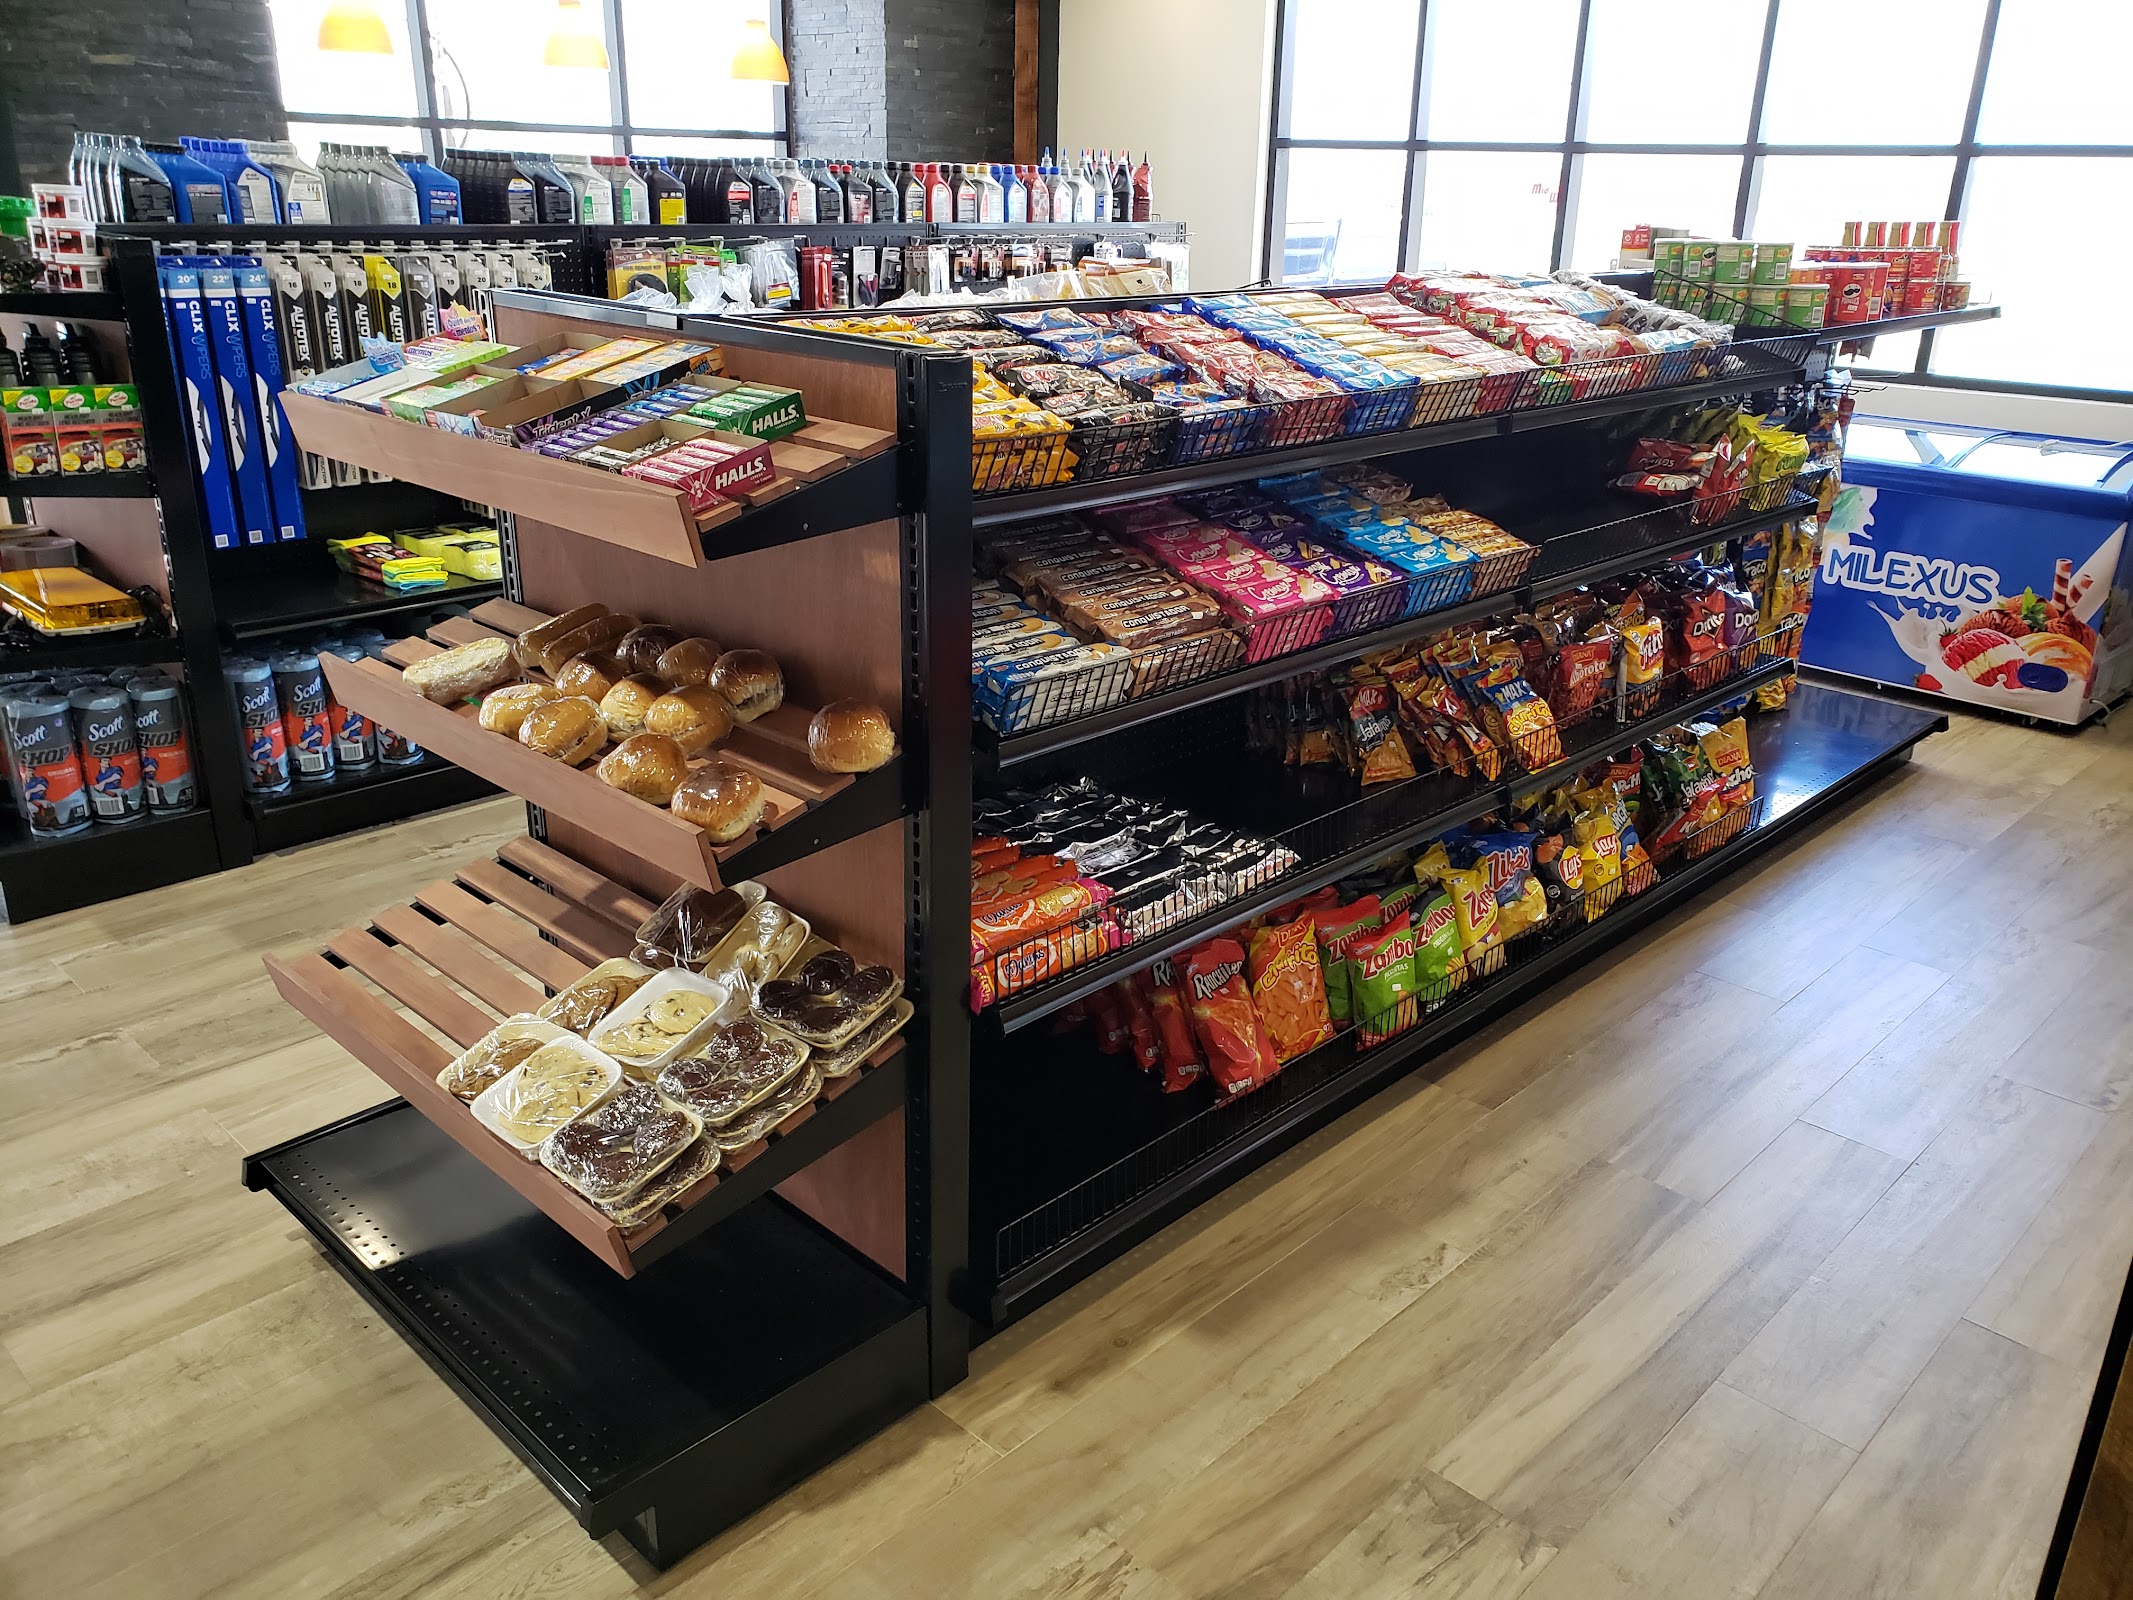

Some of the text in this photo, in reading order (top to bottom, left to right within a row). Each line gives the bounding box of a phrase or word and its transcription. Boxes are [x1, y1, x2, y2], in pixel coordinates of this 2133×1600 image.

[189, 300, 212, 380] CLIX WIPERS
[224, 300, 247, 378] CLIX WIPERS
[260, 299, 281, 376] CLIX WIPERS
[290, 305, 311, 361] AUTOTEX
[325, 304, 344, 360] AUTOTEX
[1743, 561, 1767, 578] Taco
[1793, 567, 1811, 584] aco
[1827, 549, 1994, 604] MILEXUS
[1103, 590, 1169, 611] CONQUISTADOR
[1122, 604, 1191, 628] CONQUISTADOR
[972, 637, 1045, 659] ONQUISTADOR
[242, 686, 270, 713] Scott
[293, 676, 322, 702] Scott
[1502, 682, 1525, 702] MAX
[88, 714, 125, 742] Scott
[136, 708, 161, 728] cott
[14, 725, 48, 750] Scott
[20, 746, 72, 768] SHOP
[1718, 749, 1743, 766] DIANA
[1358, 937, 1415, 980] Zambo
